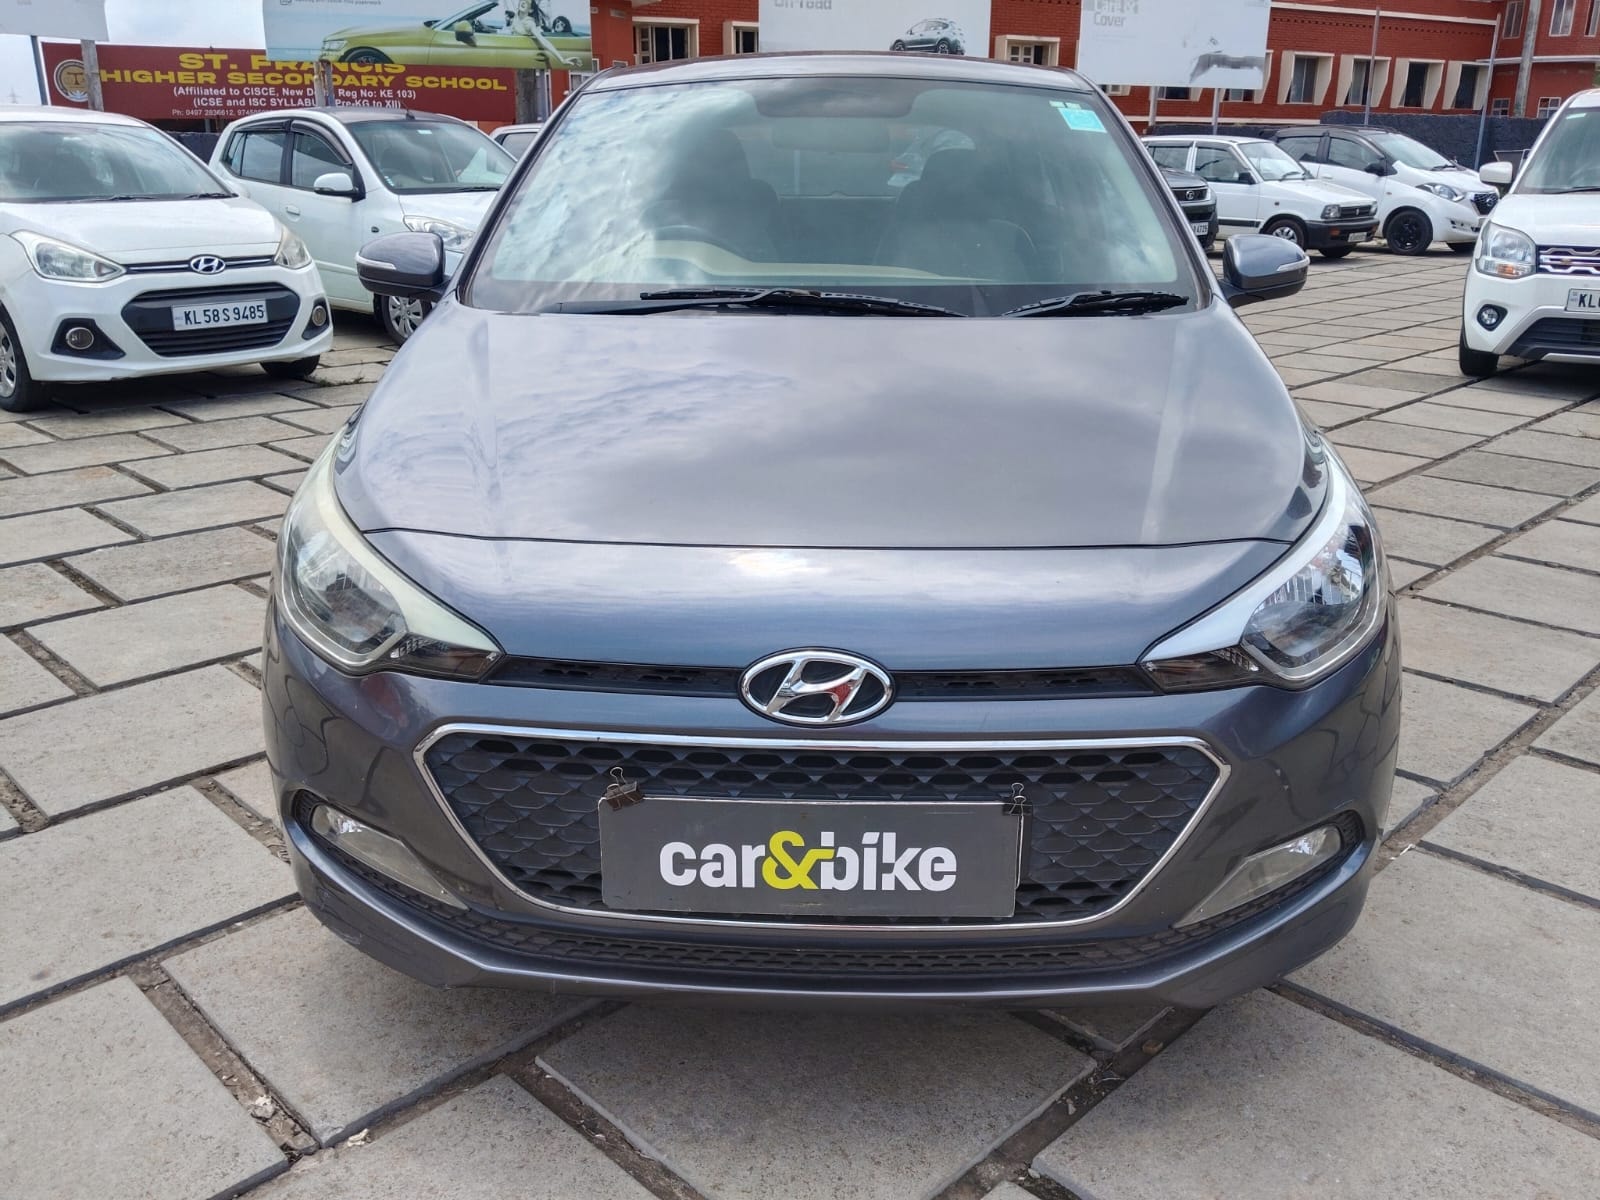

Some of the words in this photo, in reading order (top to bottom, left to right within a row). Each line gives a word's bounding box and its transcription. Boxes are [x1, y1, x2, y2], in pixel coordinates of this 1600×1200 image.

[1094, 12, 1127, 28] Cover
[178, 53, 238, 70] ST.
[101, 69, 217, 84] HIGHER
[406, 76, 508, 91] SCHOOL
[173, 86, 227, 97] (Affiliated
[229, 87, 240, 96] to
[243, 87, 279, 97] CISCE,
[282, 88, 304, 97] New
[338, 88, 358, 99] Reg
[360, 89, 377, 98] No:
[380, 89, 394, 98] KE
[397, 89, 416, 100] 103)
[193, 97, 223, 108] (ICSE
[227, 98, 246, 107] and
[249, 98, 267, 107] ISC
[270, 98, 318, 107] SYLLABU
[659, 830, 957, 892] car&bike
